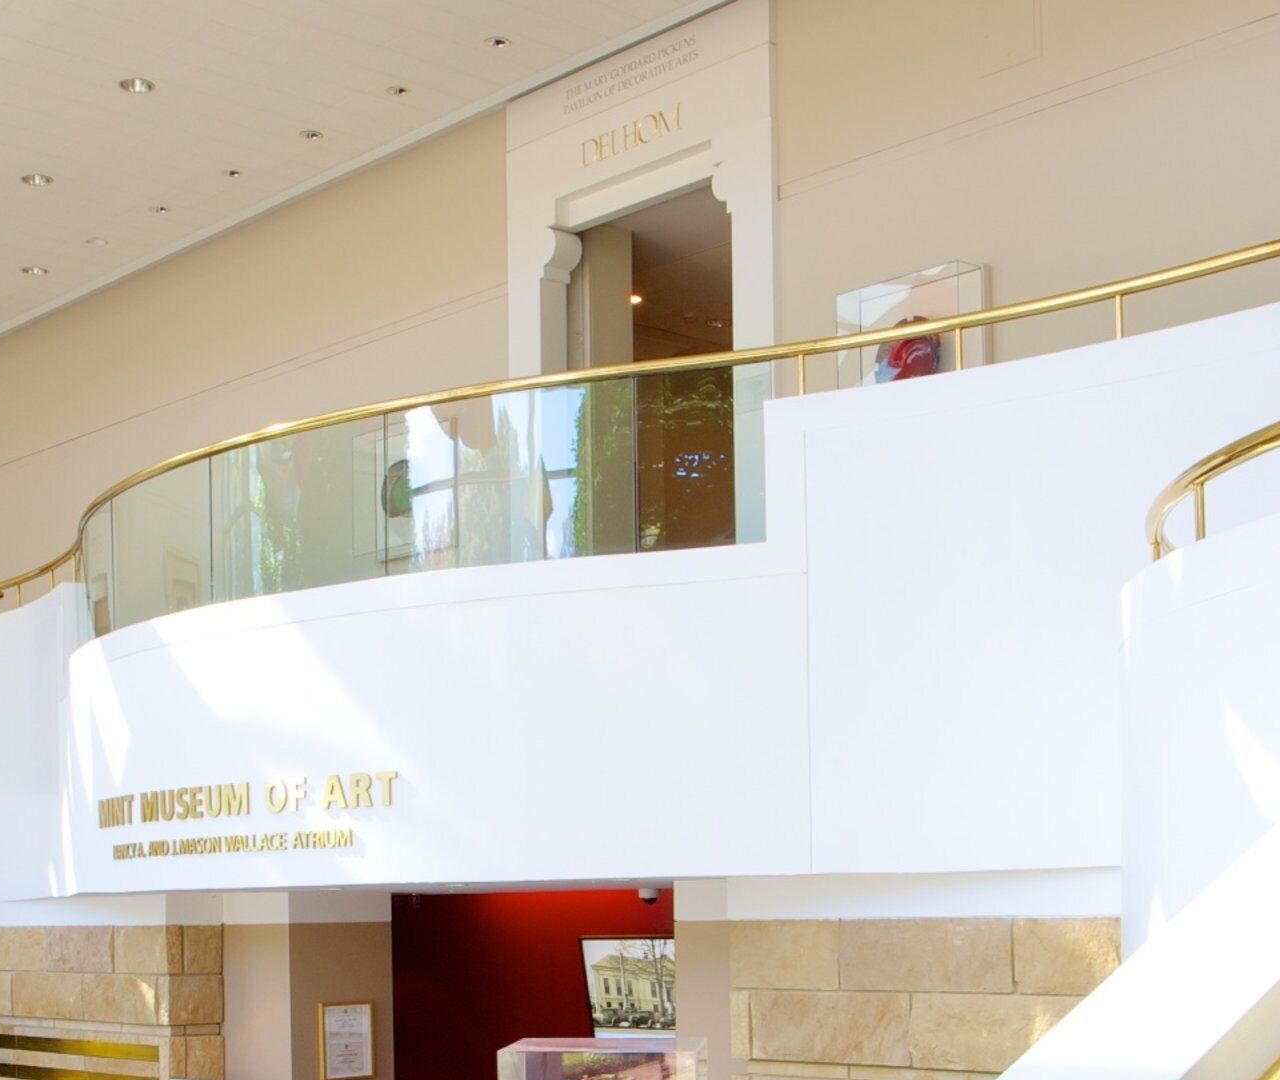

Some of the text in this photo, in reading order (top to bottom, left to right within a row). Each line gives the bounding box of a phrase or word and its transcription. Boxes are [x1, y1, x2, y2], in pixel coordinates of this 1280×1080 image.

[563, 49, 700, 115] PAVILION OF DECORATIVE ARTS
[565, 35, 697, 101] THE MARY GODDARD PICKENS
[580, 102, 683, 169] DELHOM
[140, 782, 250, 823] MUSEUM
[265, 777, 308, 815] OF
[322, 771, 399, 811] ART
[224, 831, 288, 853] WALLACE
[294, 829, 354, 850] ATRIUM
